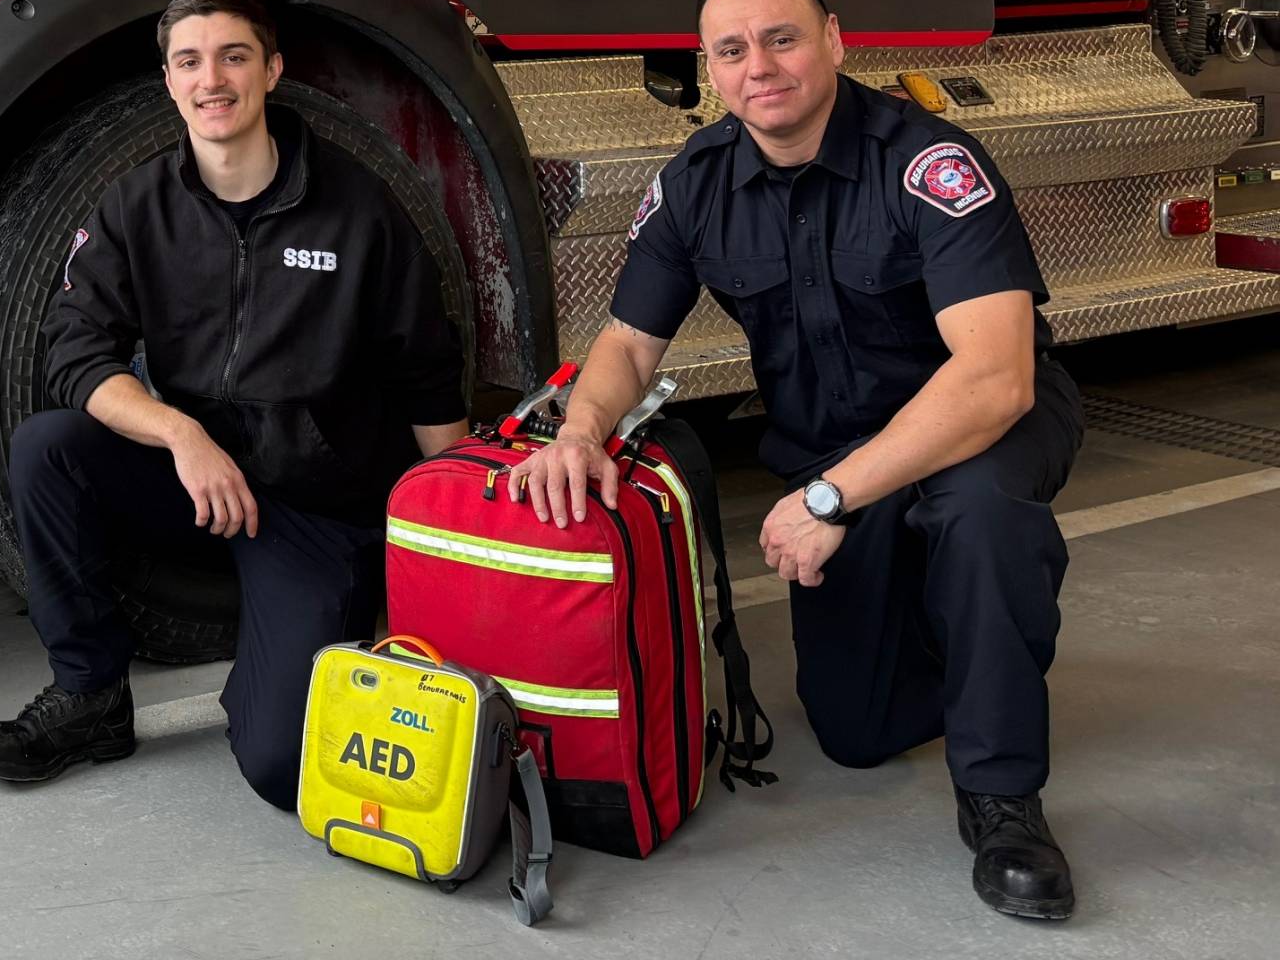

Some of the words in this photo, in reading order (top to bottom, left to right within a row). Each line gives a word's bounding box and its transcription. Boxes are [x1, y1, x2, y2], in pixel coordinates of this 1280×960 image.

[910, 147, 964, 187] BEAUHARNOIS
[953, 186, 989, 211] INCENDIE
[283, 247, 337, 271] SSIB
[338, 731, 416, 781] AED
